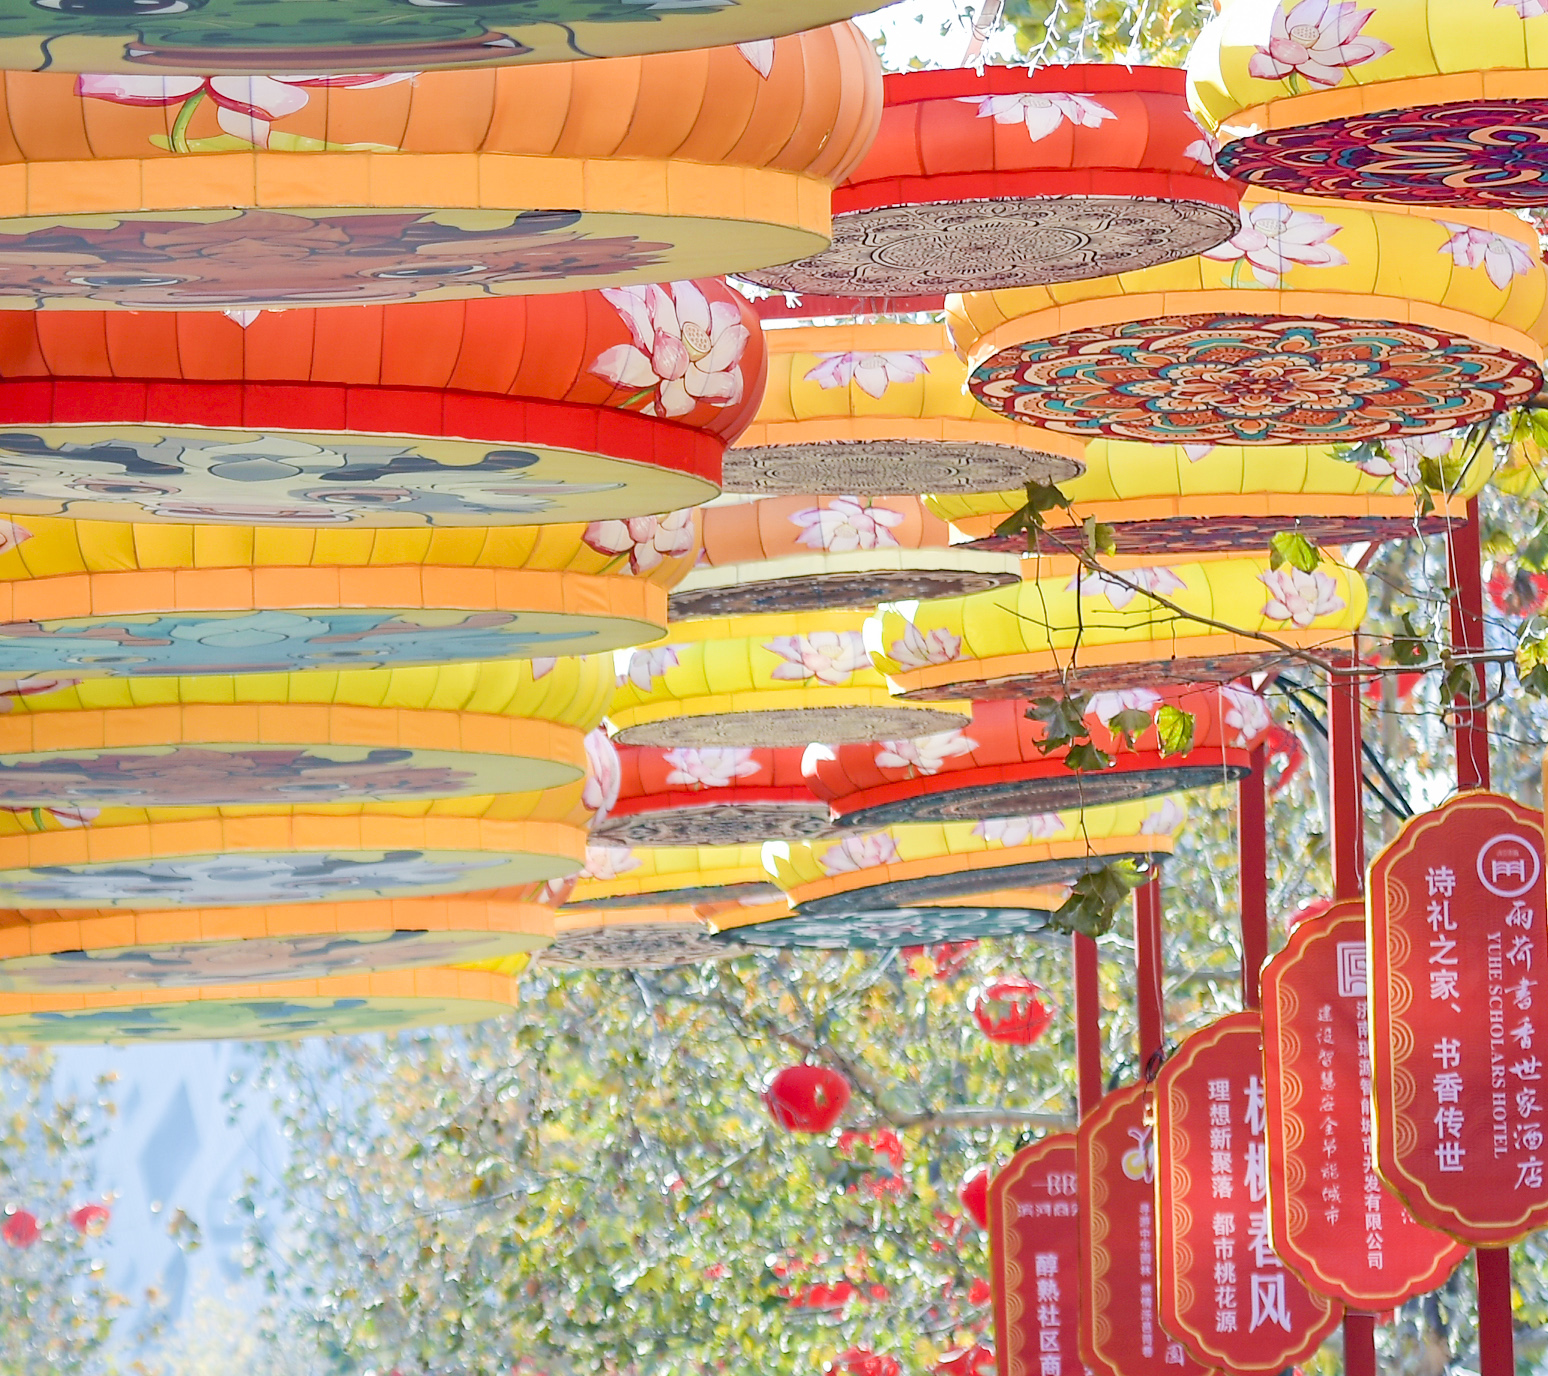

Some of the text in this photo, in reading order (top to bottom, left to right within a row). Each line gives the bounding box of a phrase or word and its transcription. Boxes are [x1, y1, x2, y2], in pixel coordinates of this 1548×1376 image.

[1424, 865, 1466, 1172] 诗礼之家、 书香传世
[1487, 931, 1509, 1159] YUHE SCHOLARS HOTEL
[1207, 1079, 1238, 1333] 理想新聚落 都市桃花源
